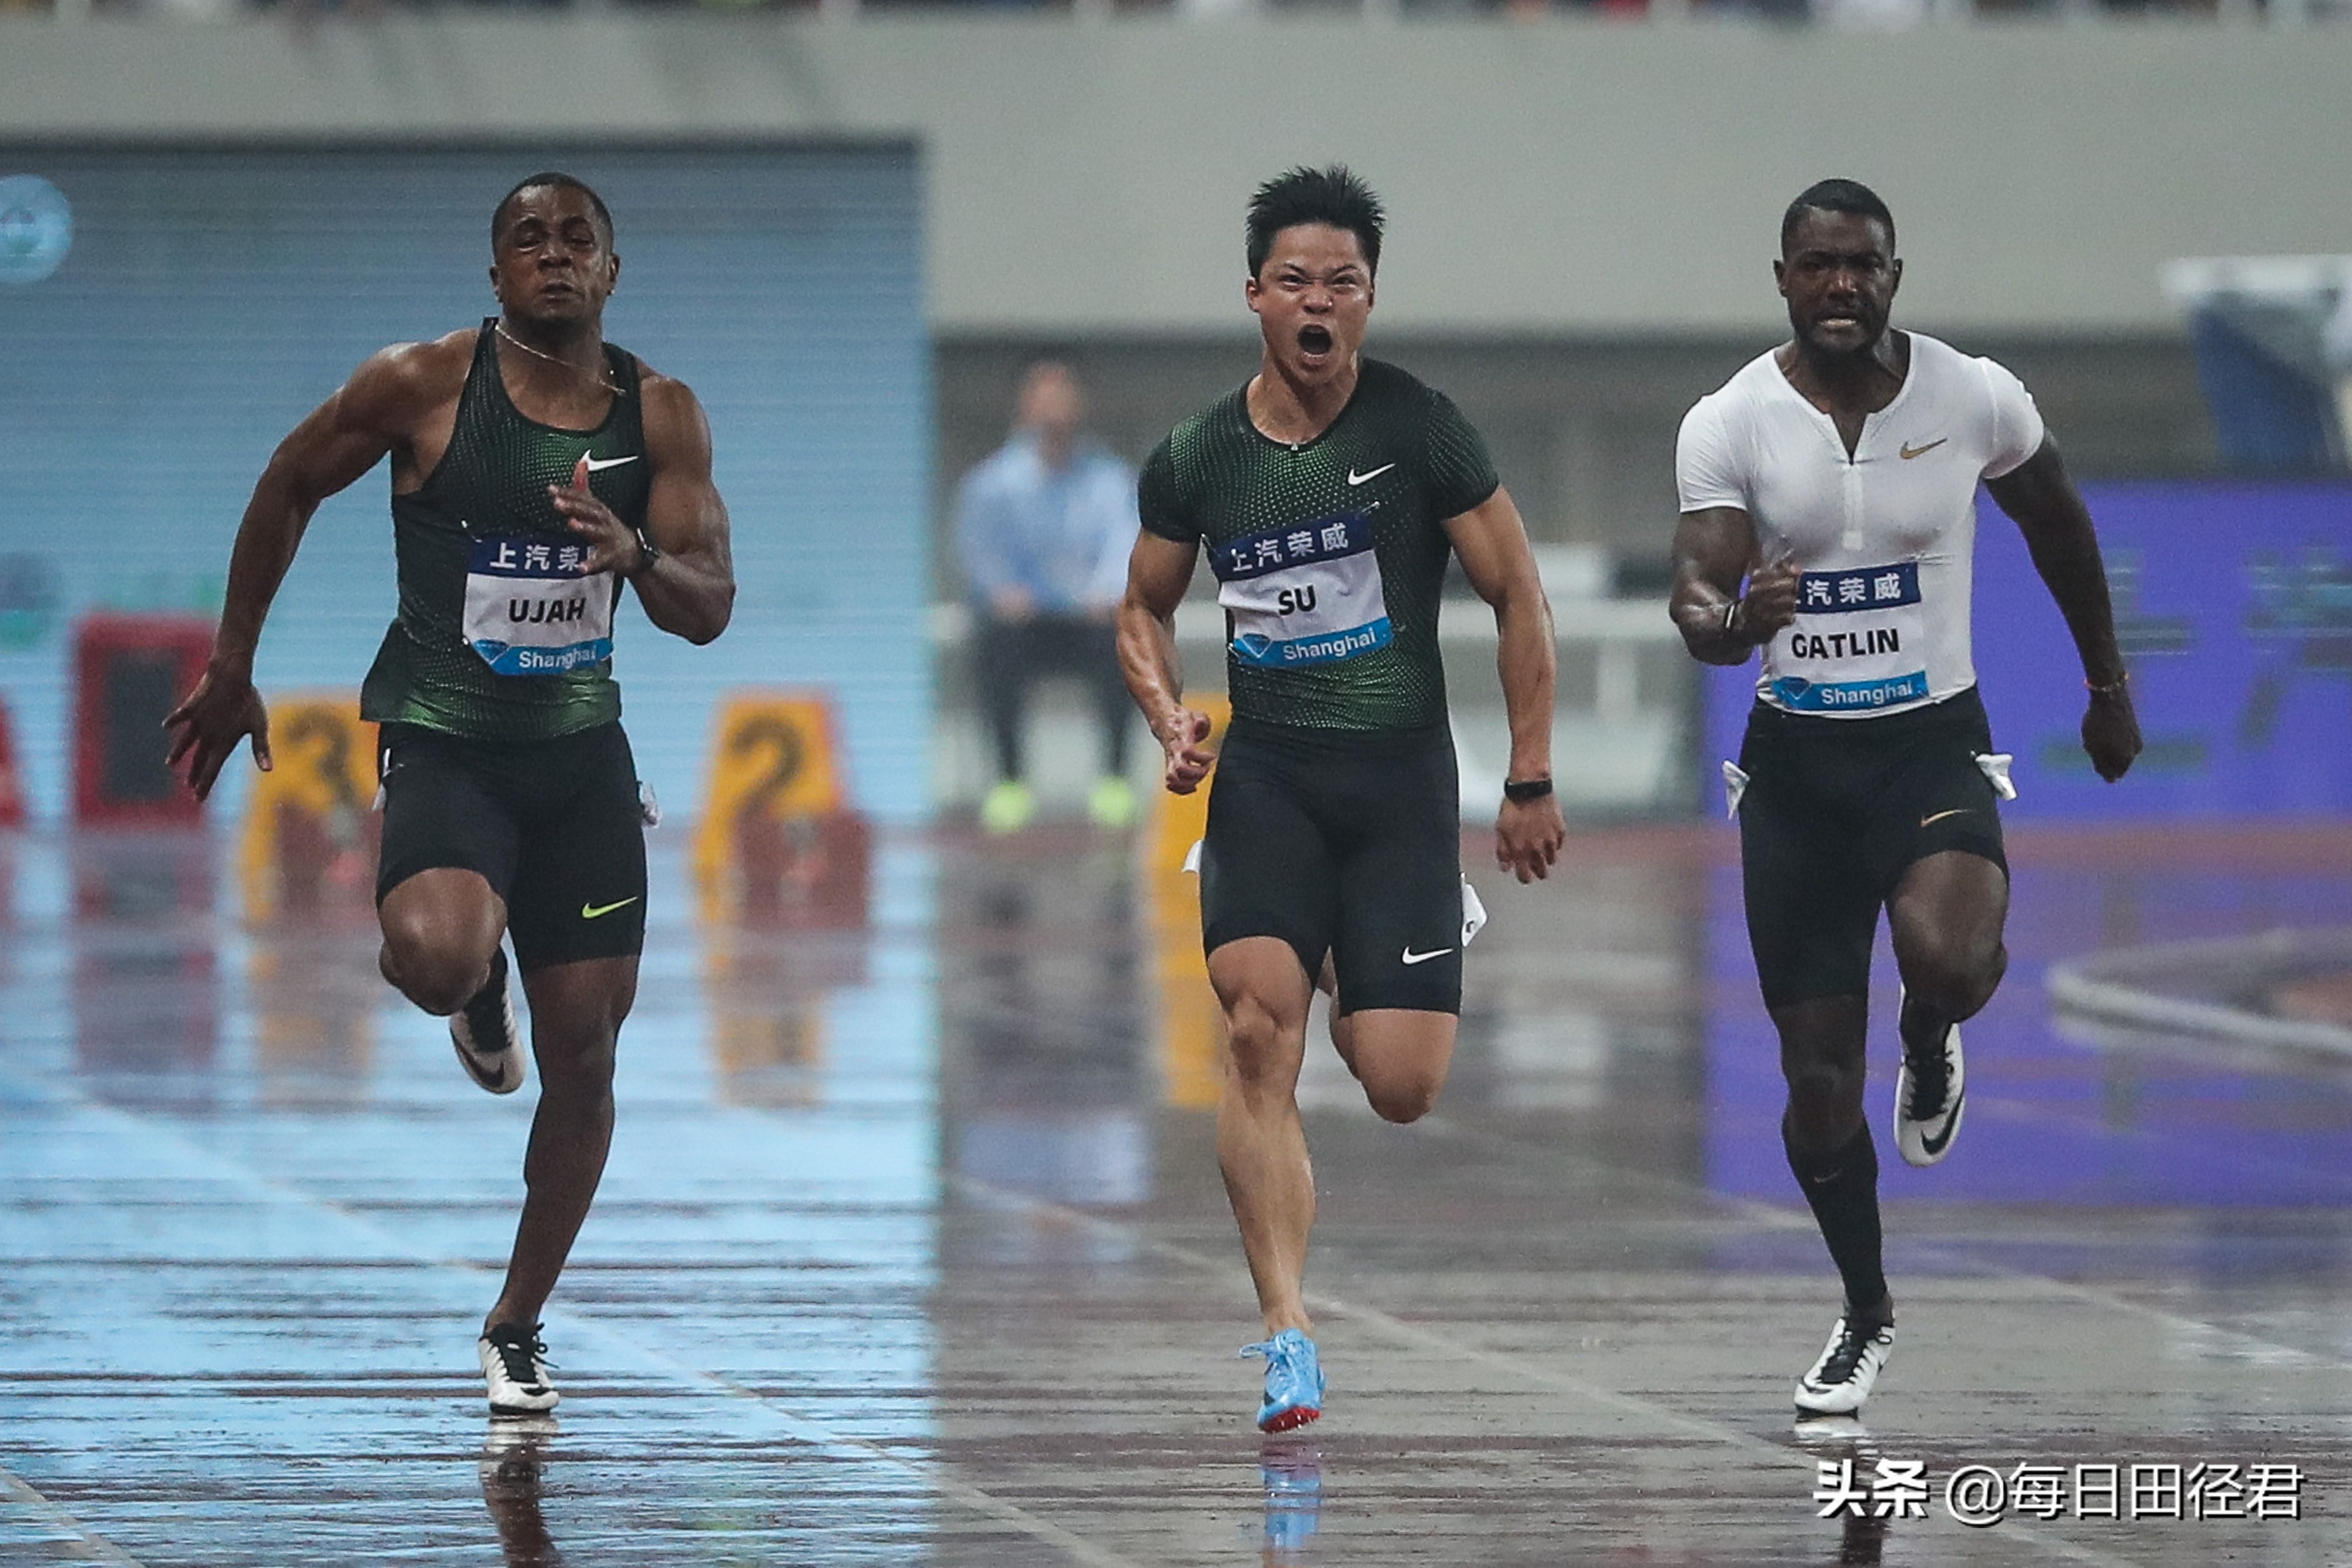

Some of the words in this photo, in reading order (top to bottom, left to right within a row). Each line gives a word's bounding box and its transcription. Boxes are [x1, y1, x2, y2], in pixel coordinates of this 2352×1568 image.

[490, 542, 596, 571] 上汽荣
[1232, 522, 1349, 571] 上汽荣威
[1278, 585, 1317, 615] SU
[1795, 573, 1902, 606] 汽荣威
[509, 598, 586, 623] UJAH
[519, 646, 597, 669] Shanghai
[1284, 627, 1377, 660] Shanghai
[1791, 628, 1900, 659] GATLIN
[1820, 681, 1912, 704] Shanghai
